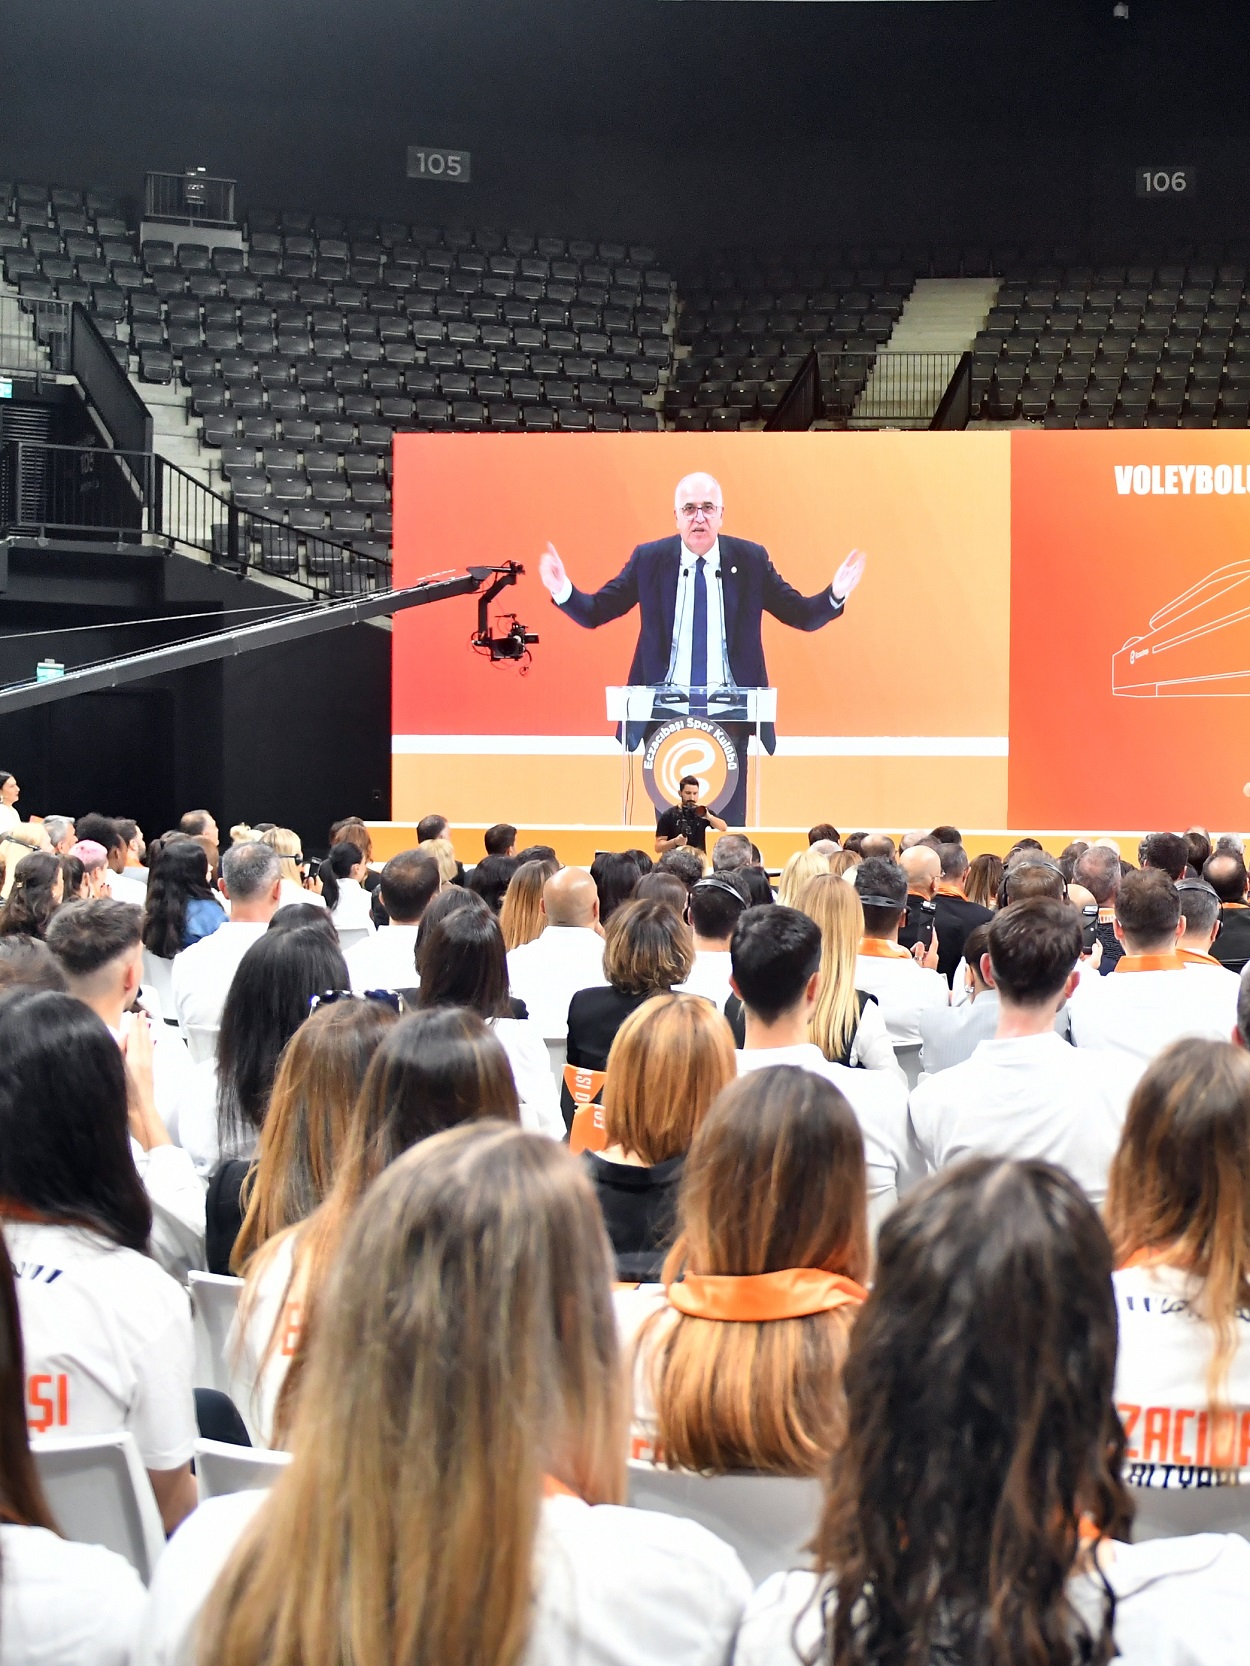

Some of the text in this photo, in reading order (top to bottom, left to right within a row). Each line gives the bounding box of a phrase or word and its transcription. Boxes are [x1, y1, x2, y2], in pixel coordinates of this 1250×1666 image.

[416, 153, 462, 176] 105
[1142, 171, 1187, 192] 106
[686, 717, 714, 734] Spor
